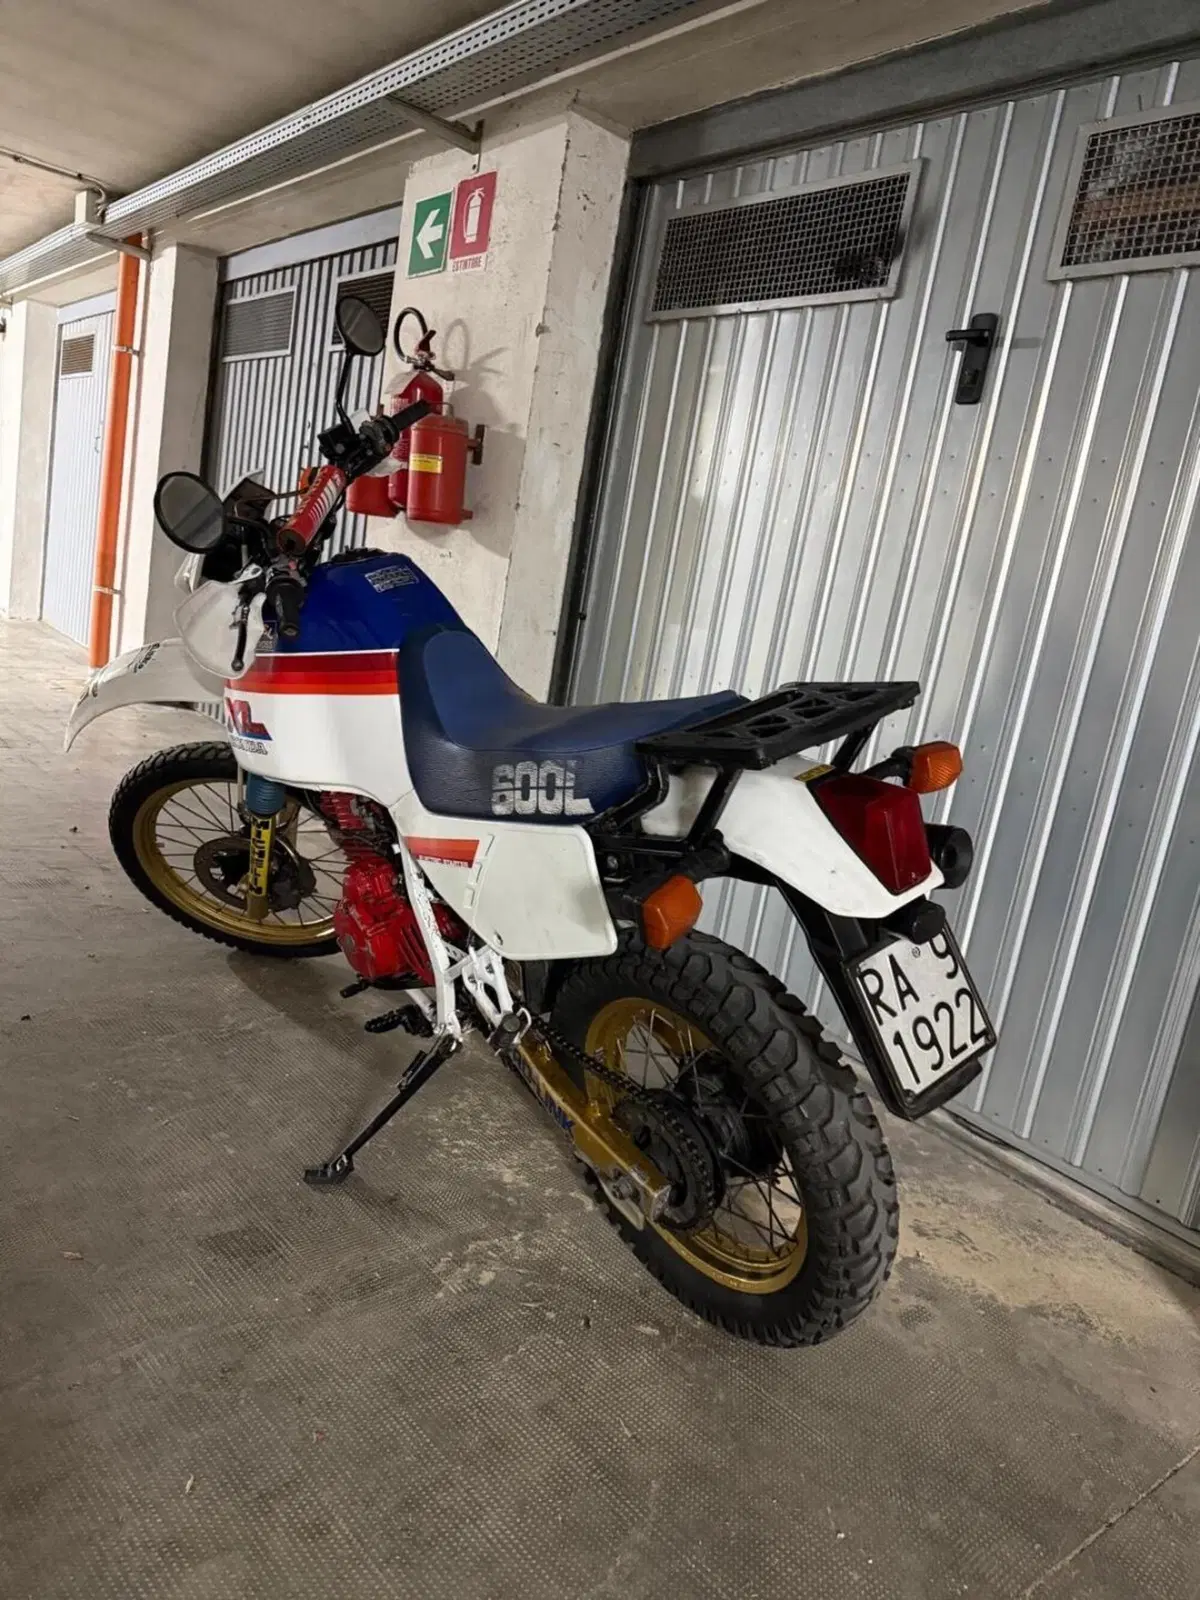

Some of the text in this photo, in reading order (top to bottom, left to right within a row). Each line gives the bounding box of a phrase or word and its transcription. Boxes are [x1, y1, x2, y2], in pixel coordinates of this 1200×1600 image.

[491, 760, 595, 816] 600L
[857, 932, 958, 1026] RA 9
[893, 987, 988, 1084] 1922
